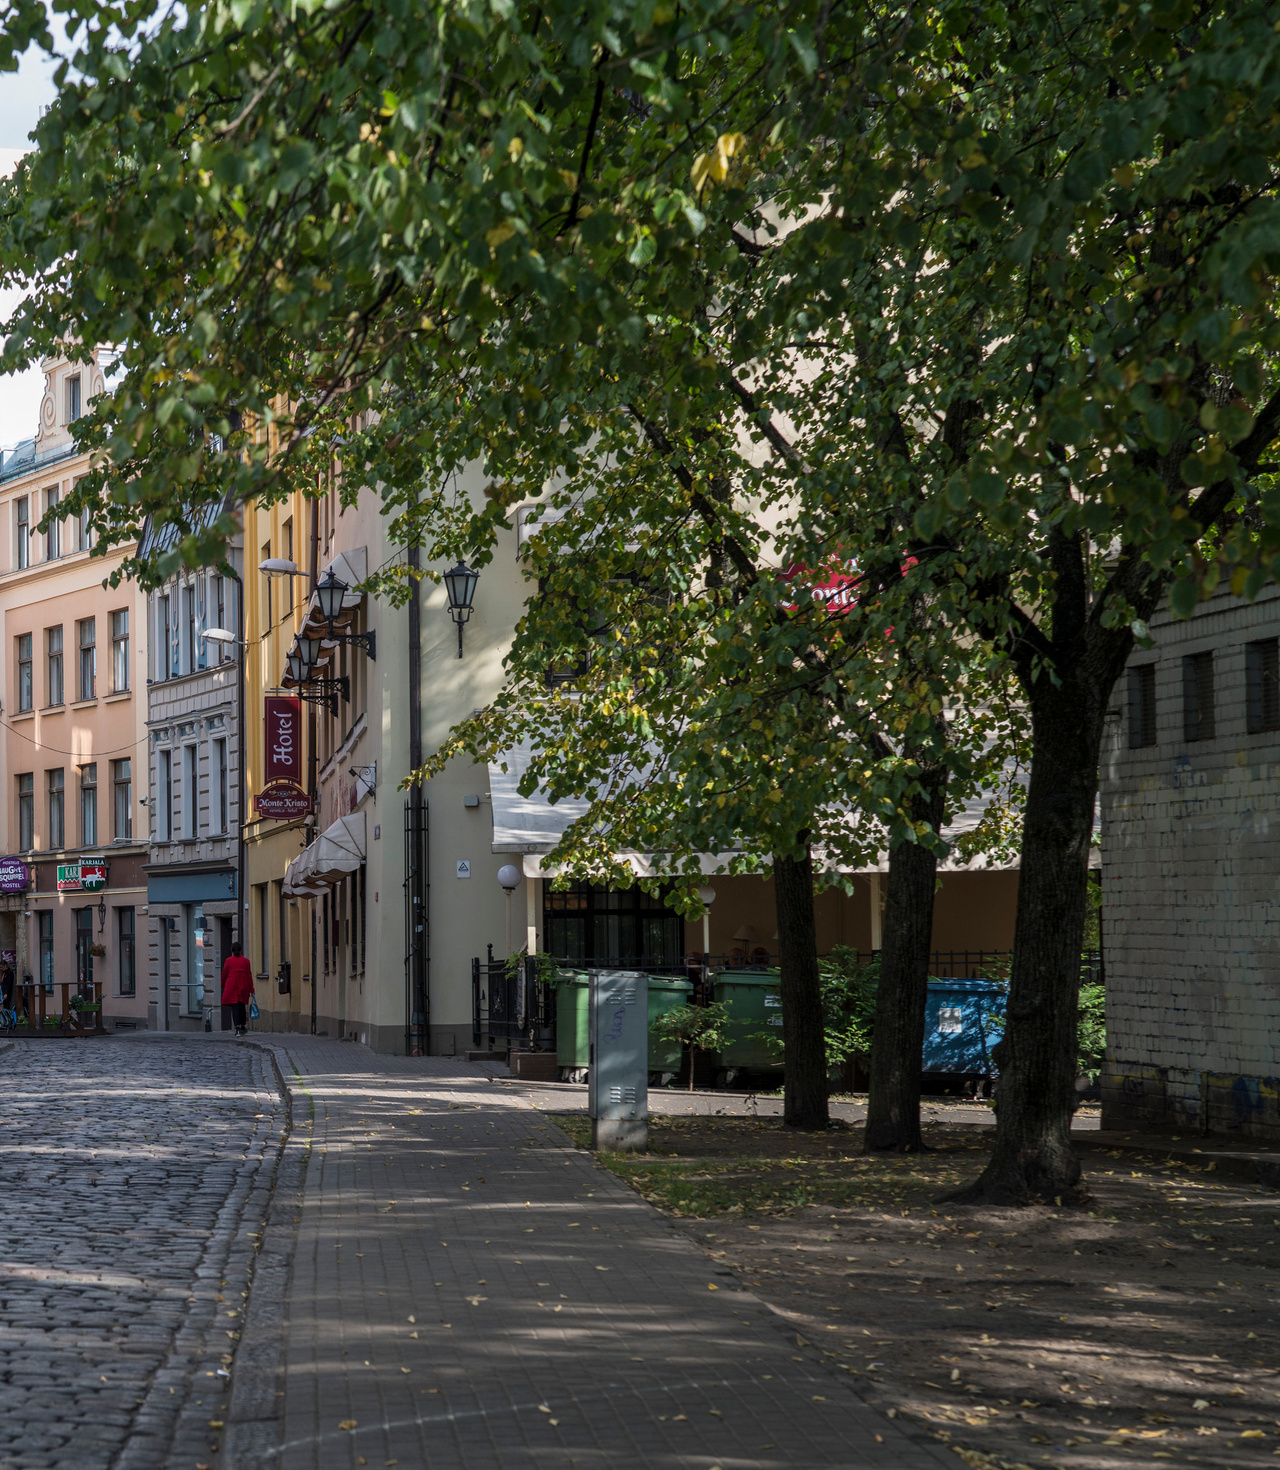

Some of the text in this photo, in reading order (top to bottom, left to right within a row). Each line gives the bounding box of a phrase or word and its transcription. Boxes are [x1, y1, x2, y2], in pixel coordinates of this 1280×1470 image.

[273, 711, 293, 765] Hotel
[259, 799, 308, 807] Monte Kristo
